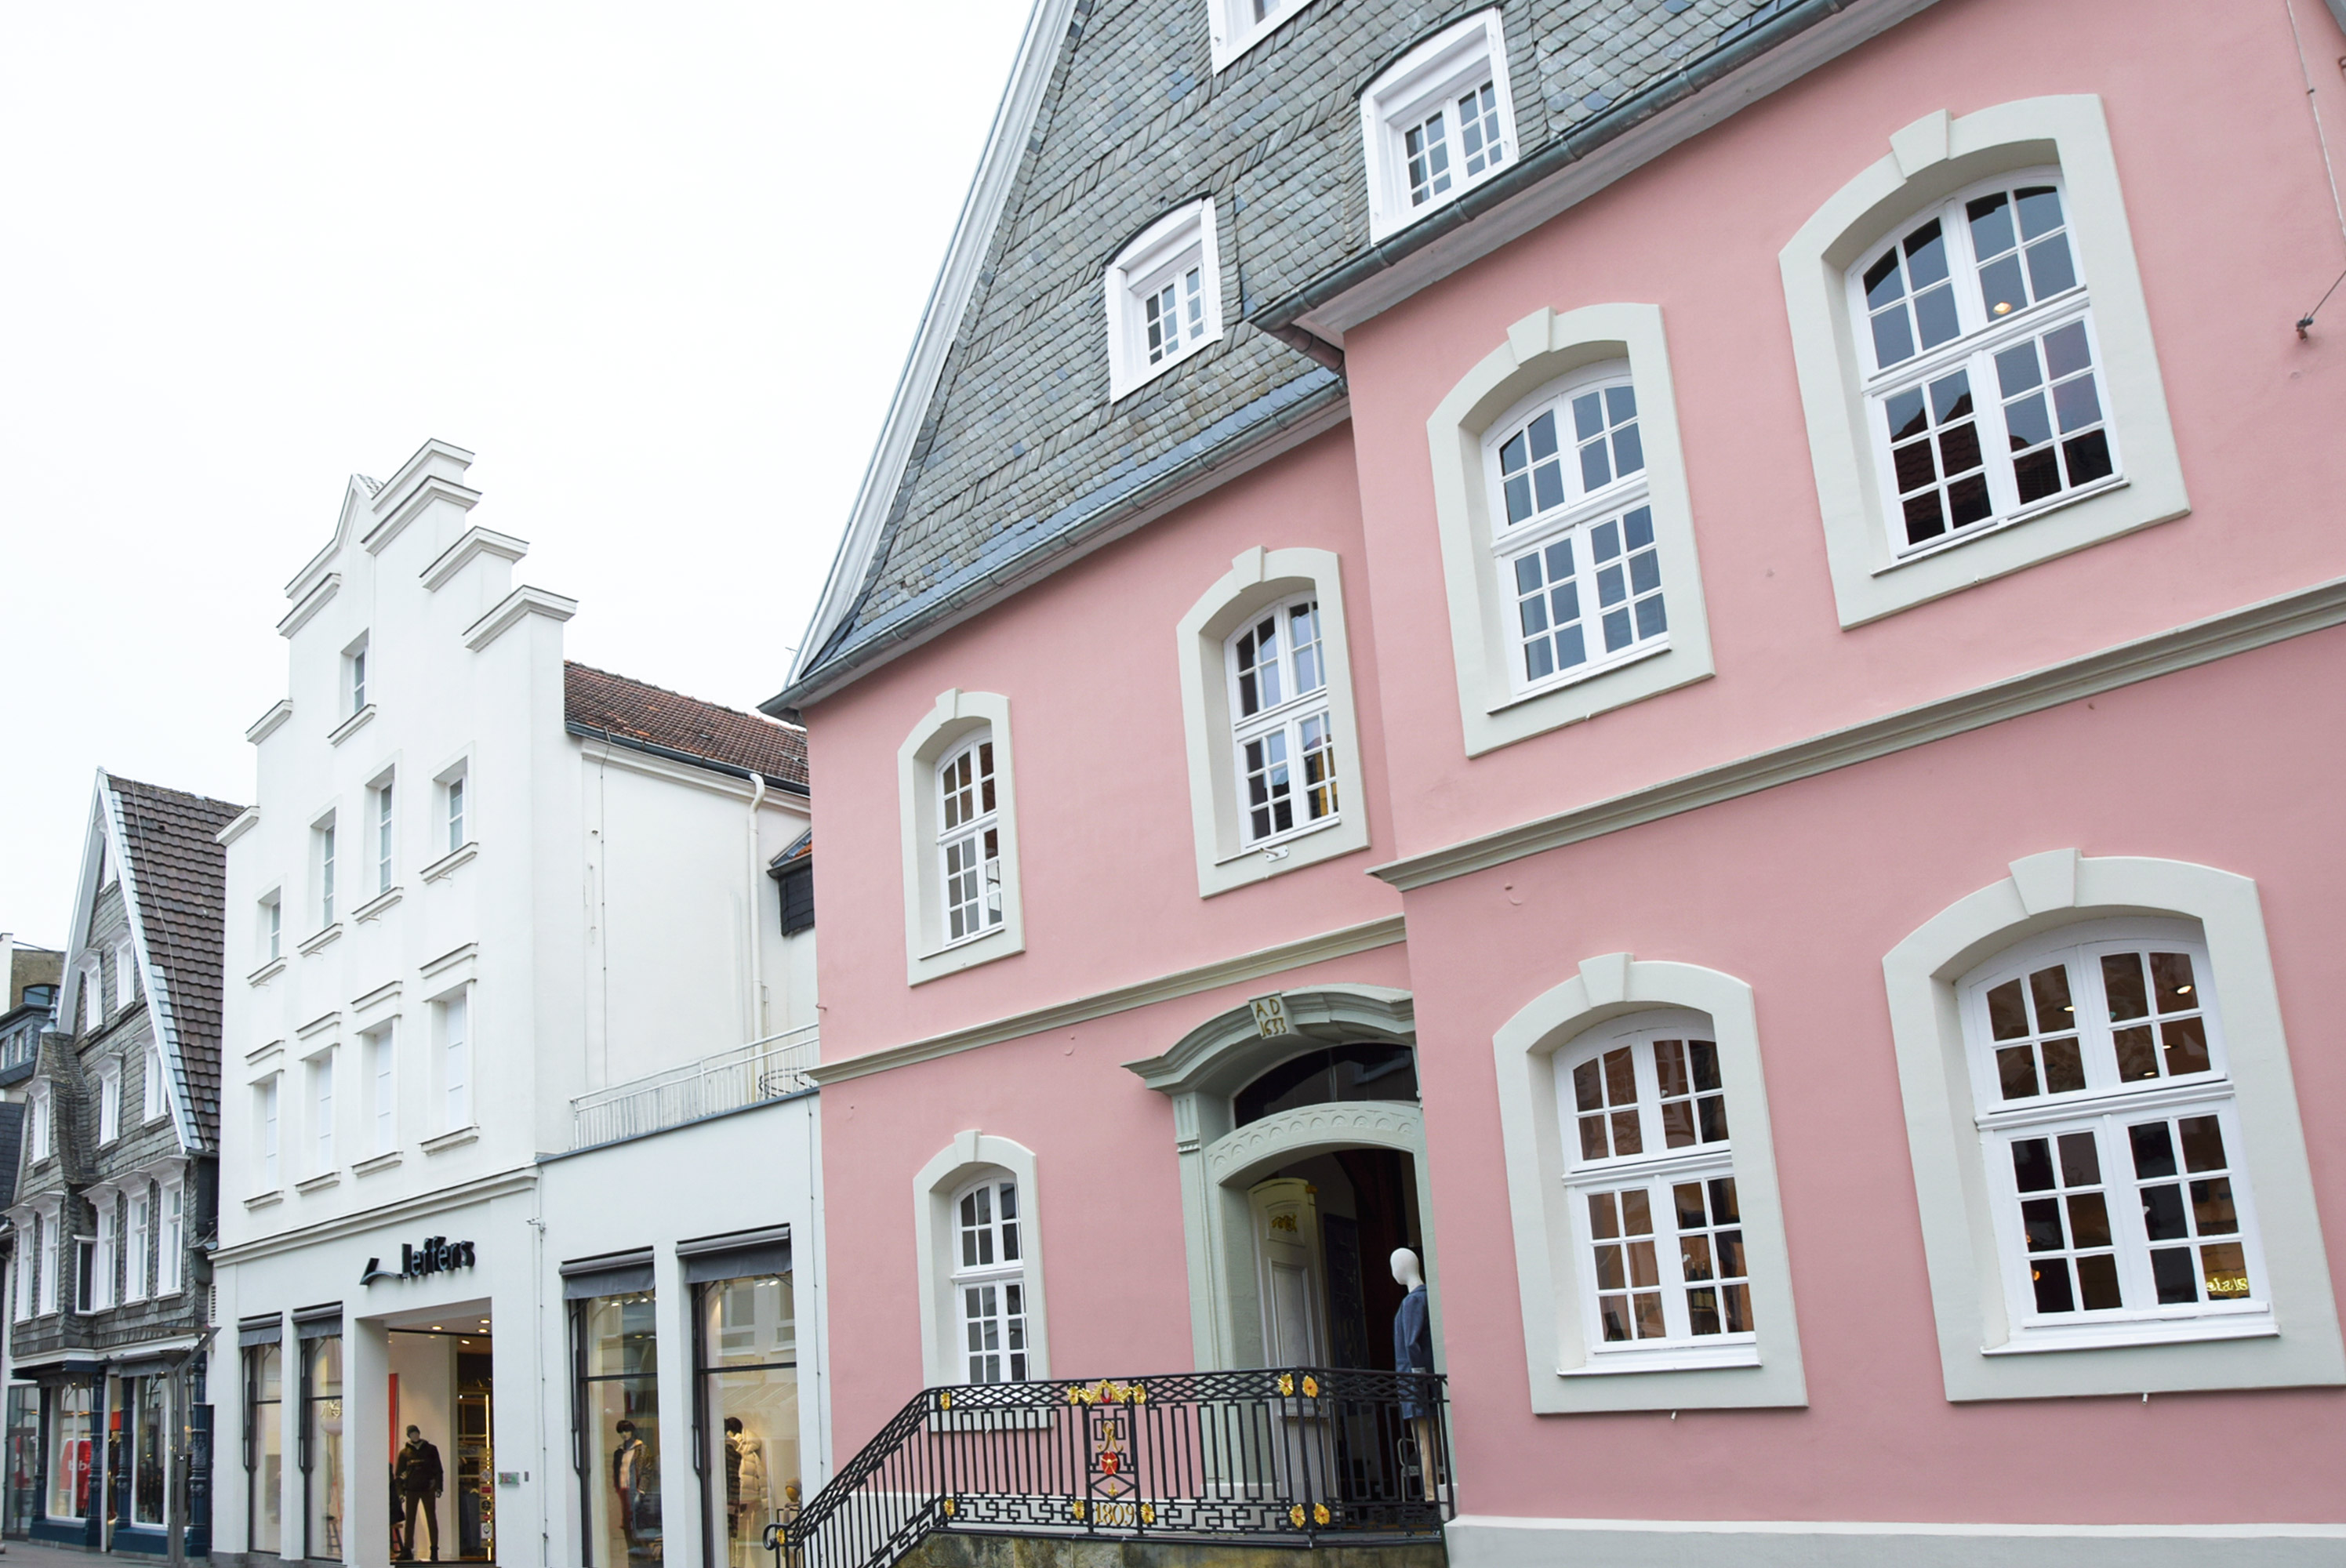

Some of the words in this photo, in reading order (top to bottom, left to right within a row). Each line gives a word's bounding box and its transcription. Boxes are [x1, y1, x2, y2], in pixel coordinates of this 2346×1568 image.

[1259, 1016, 1287, 1037] 1633
[401, 1236, 475, 1278] leffers
[1095, 1503, 1135, 1526] 1809
